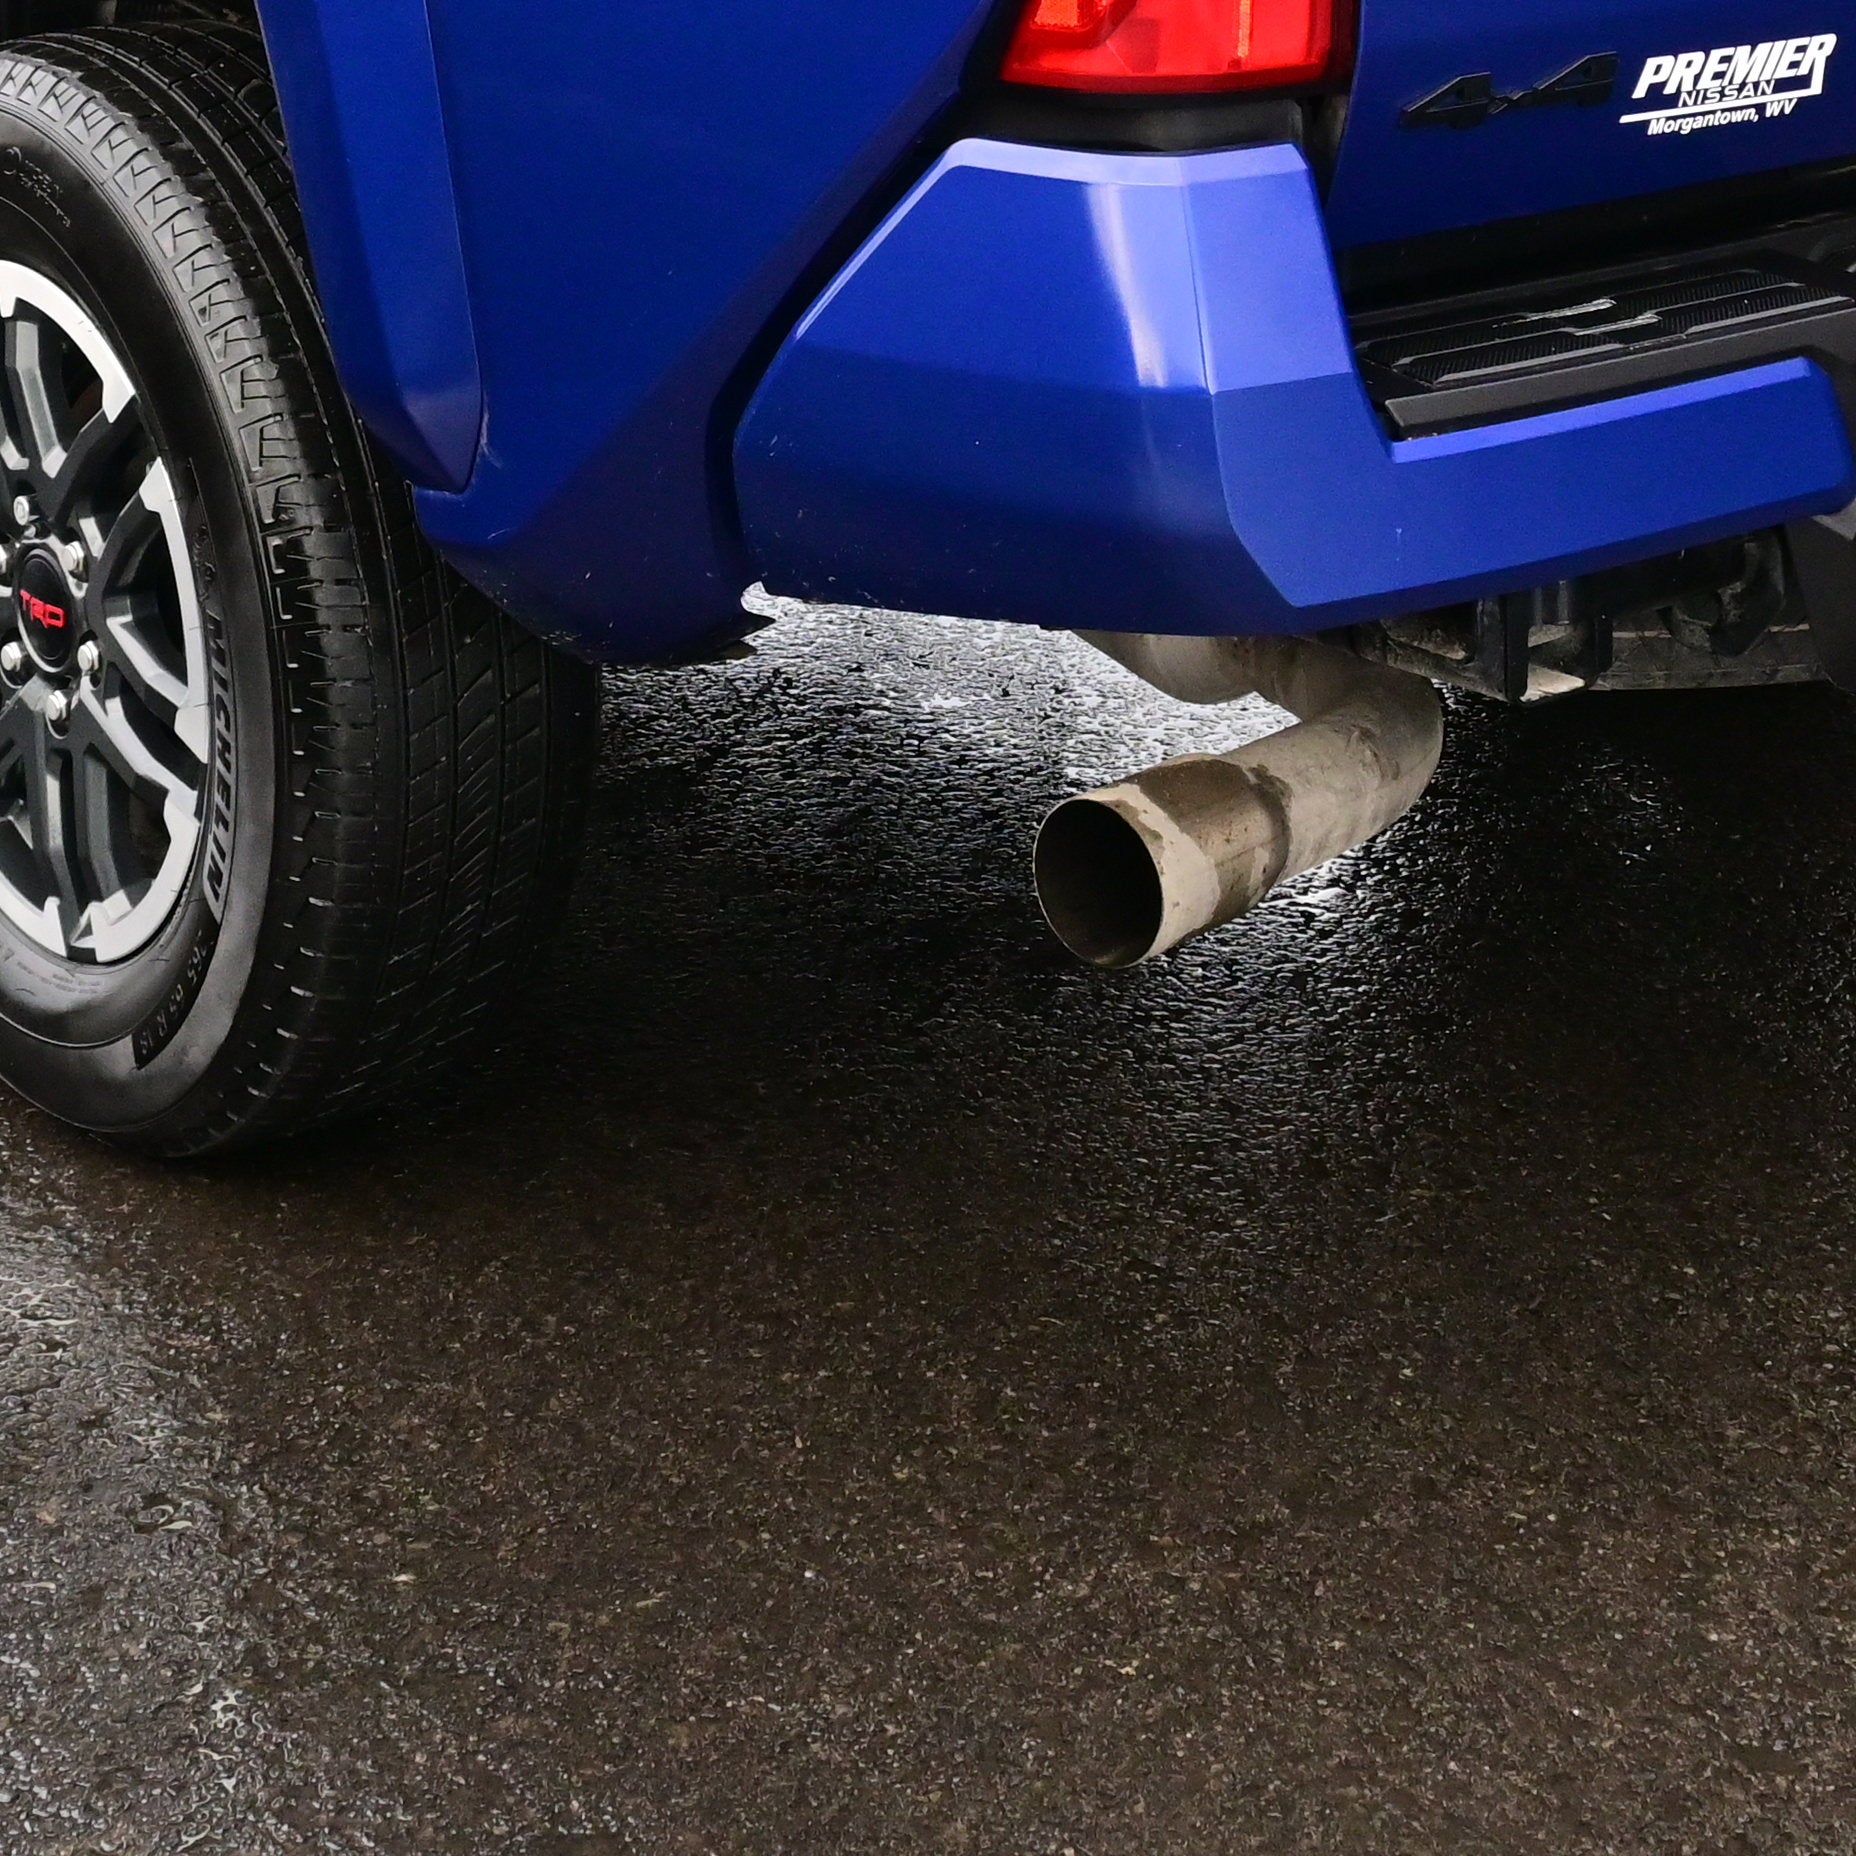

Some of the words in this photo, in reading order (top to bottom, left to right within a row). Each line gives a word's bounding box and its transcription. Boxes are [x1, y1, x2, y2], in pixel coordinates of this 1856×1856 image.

[1631, 33, 1837, 98] PREMIER
[1677, 79, 1775, 108] NISSAN
[1647, 107, 1760, 136] Morgantown,
[1764, 98, 1797, 119] WV
[20, 589, 65, 629] TRD
[206, 612, 232, 902] MICHELIN
